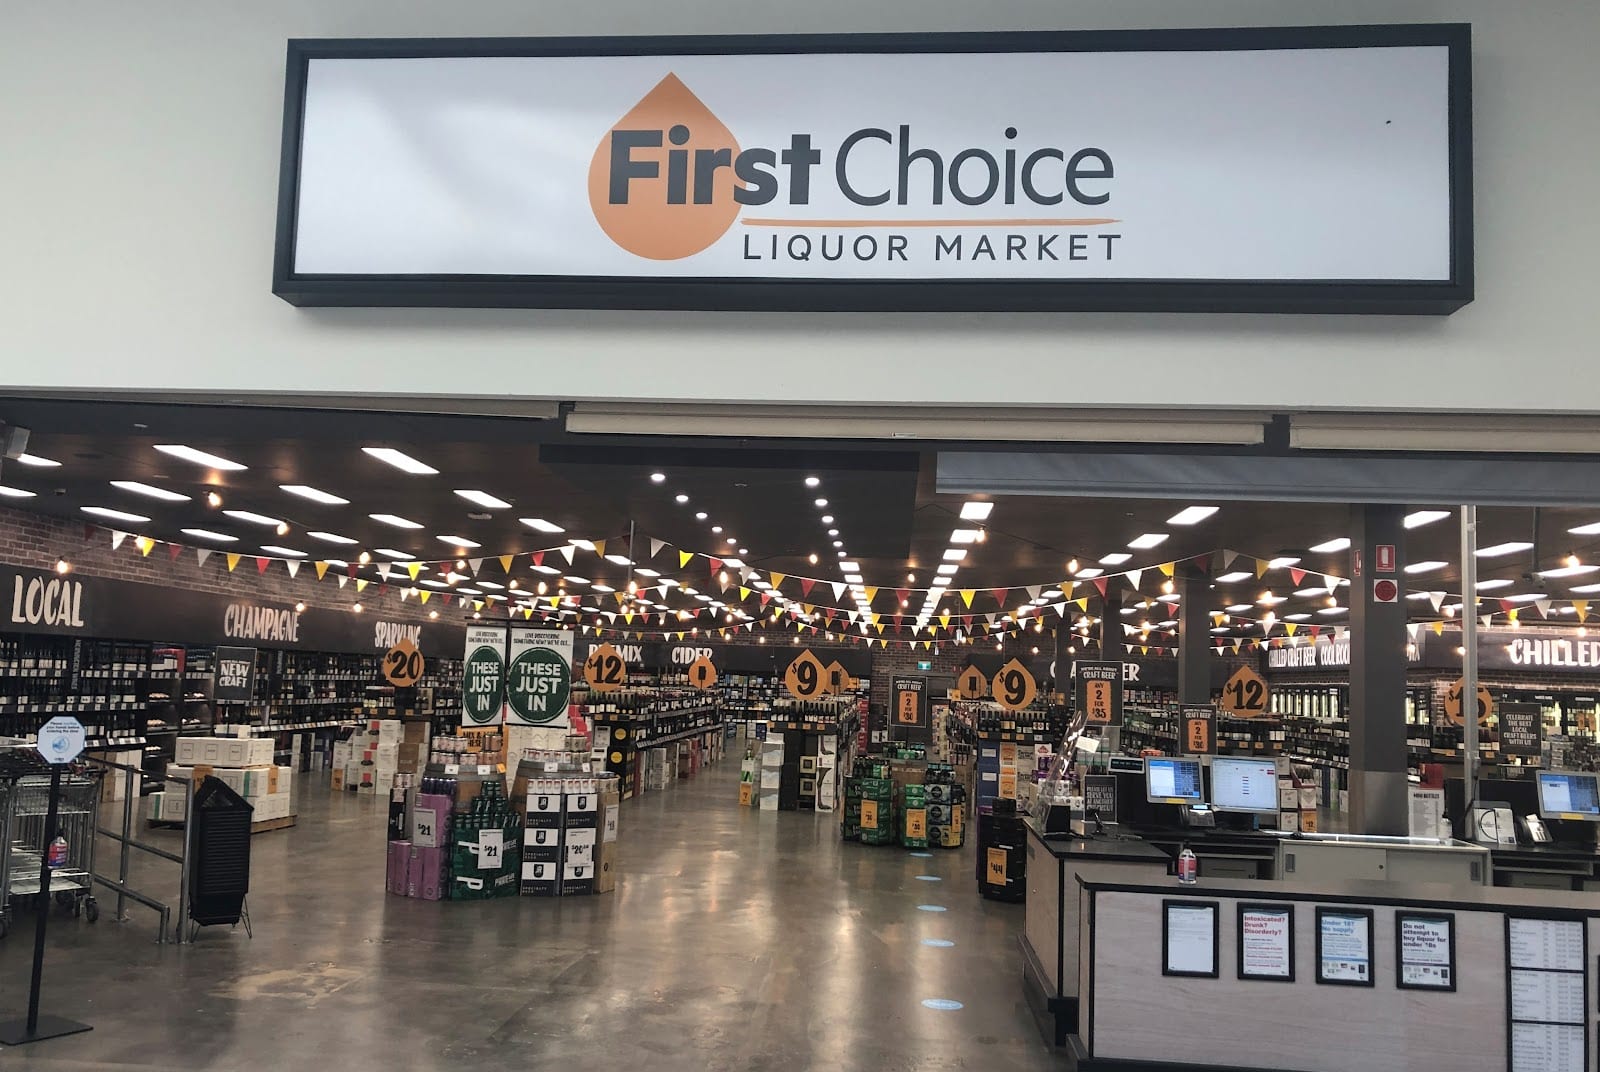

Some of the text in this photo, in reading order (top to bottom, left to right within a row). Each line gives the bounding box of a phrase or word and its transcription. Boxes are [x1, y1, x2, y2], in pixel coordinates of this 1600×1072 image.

[608, 125, 1114, 206] First Choice
[744, 234, 1122, 262] LIQUOR MARKET
[11, 574, 84, 627] LOCAL
[224, 604, 300, 642] CHAMPAGNE
[588, 644, 643, 662] PMIX
[671, 646, 713, 664] CIDER
[1336, 644, 1350, 664] ROO
[1510, 638, 1600, 667] CHILLED
[221, 663, 250, 677] NEW
[387, 650, 420, 680] $20
[471, 661, 500, 674] THESE
[518, 662, 561, 676] THESE
[587, 654, 622, 684] $12
[1122, 663, 1140, 681] ER
[219, 676, 248, 688] CRAFT
[792, 660, 818, 695] $9
[1083, 671, 1116, 680] CRAFT BEER
[469, 676, 500, 693] JUST
[516, 676, 562, 694] JUST
[999, 669, 1026, 705] $9
[477, 694, 490, 711] IN
[527, 695, 547, 711] IN
[1096, 689, 1103, 700] 2
[1226, 679, 1264, 710] $12
[1092, 707, 1107, 719] $35
[1195, 726, 1201, 735] 2
[418, 823, 431, 836] $21
[484, 845, 498, 857] $21
[1244, 915, 1286, 923] Intoxicated?
[1244, 928, 1282, 936] Disorderly?
